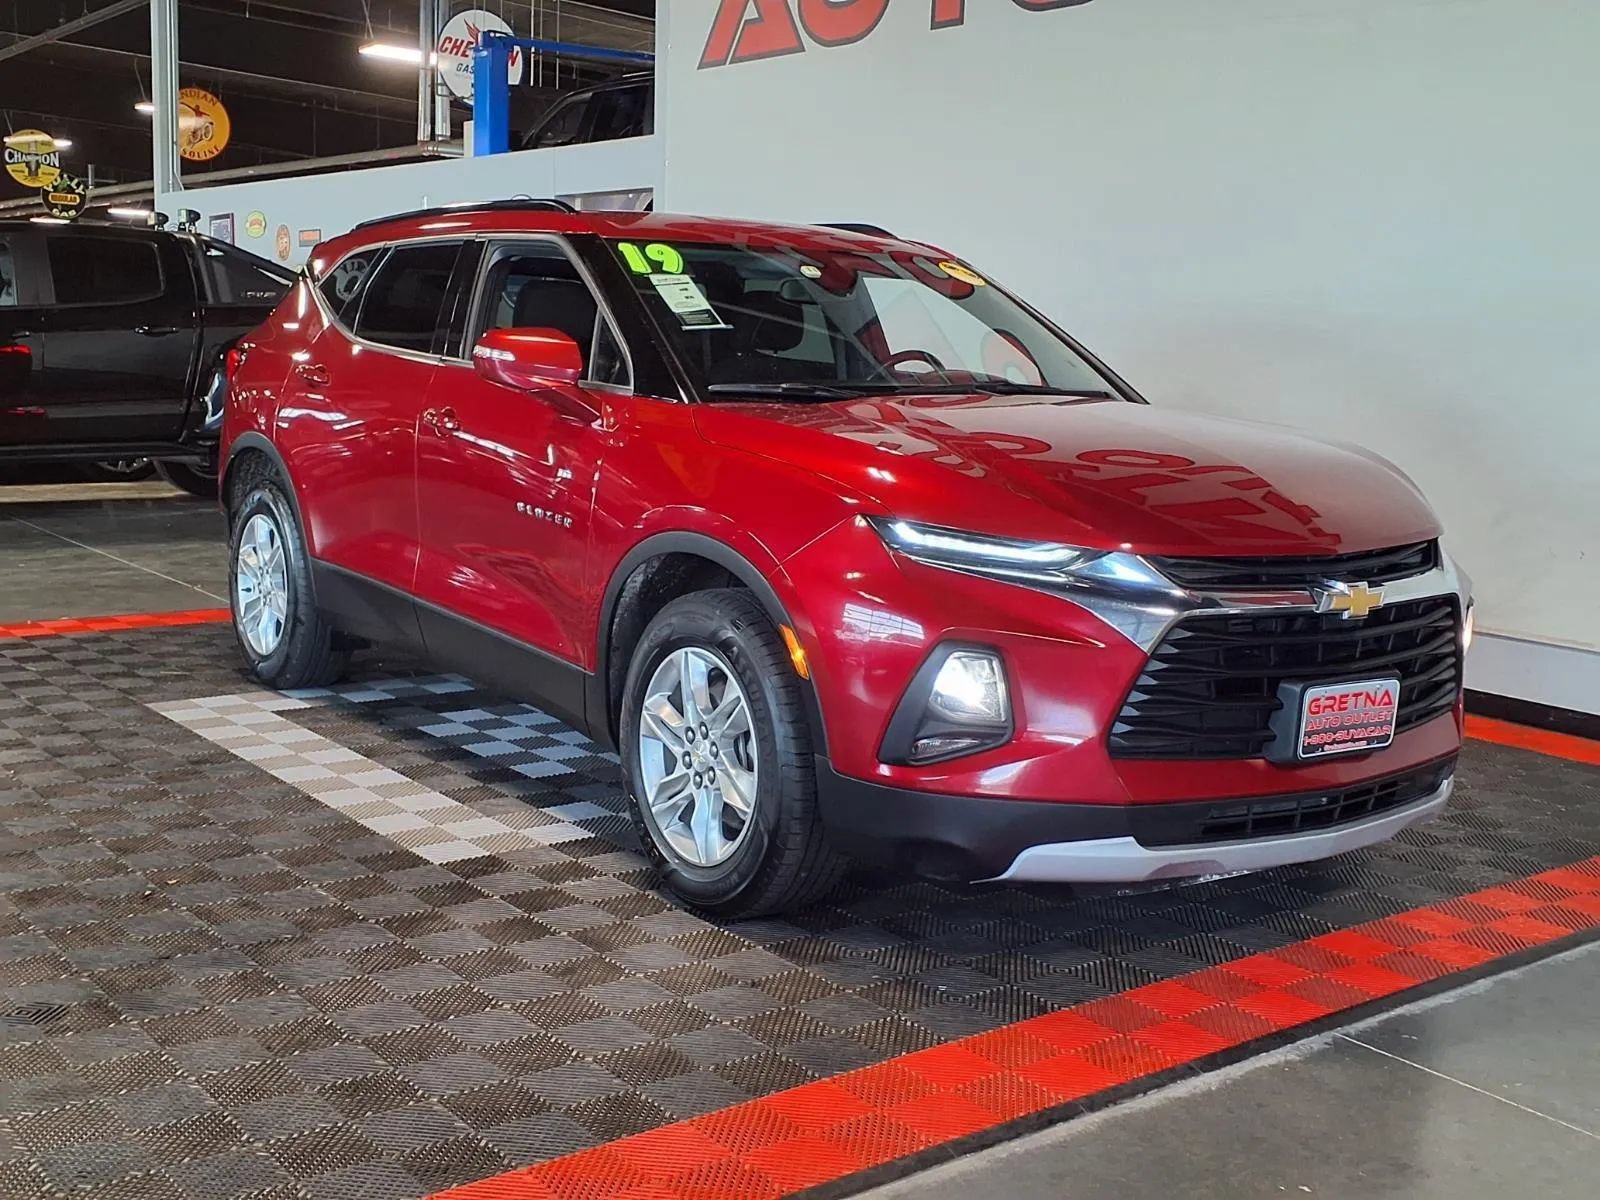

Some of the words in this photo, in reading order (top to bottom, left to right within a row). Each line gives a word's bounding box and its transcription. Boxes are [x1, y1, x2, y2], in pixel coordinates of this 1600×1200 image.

[440, 36, 519, 67] CHEN
[4, 148, 60, 168] CHAION
[182, 145, 220, 158] SOLINE
[617, 242, 684, 274] 19
[516, 501, 573, 529] BLAZER
[1308, 689, 1393, 716] GRETNA
[1306, 716, 1340, 731] AUTO
[1343, 710, 1393, 725] OUTLET
